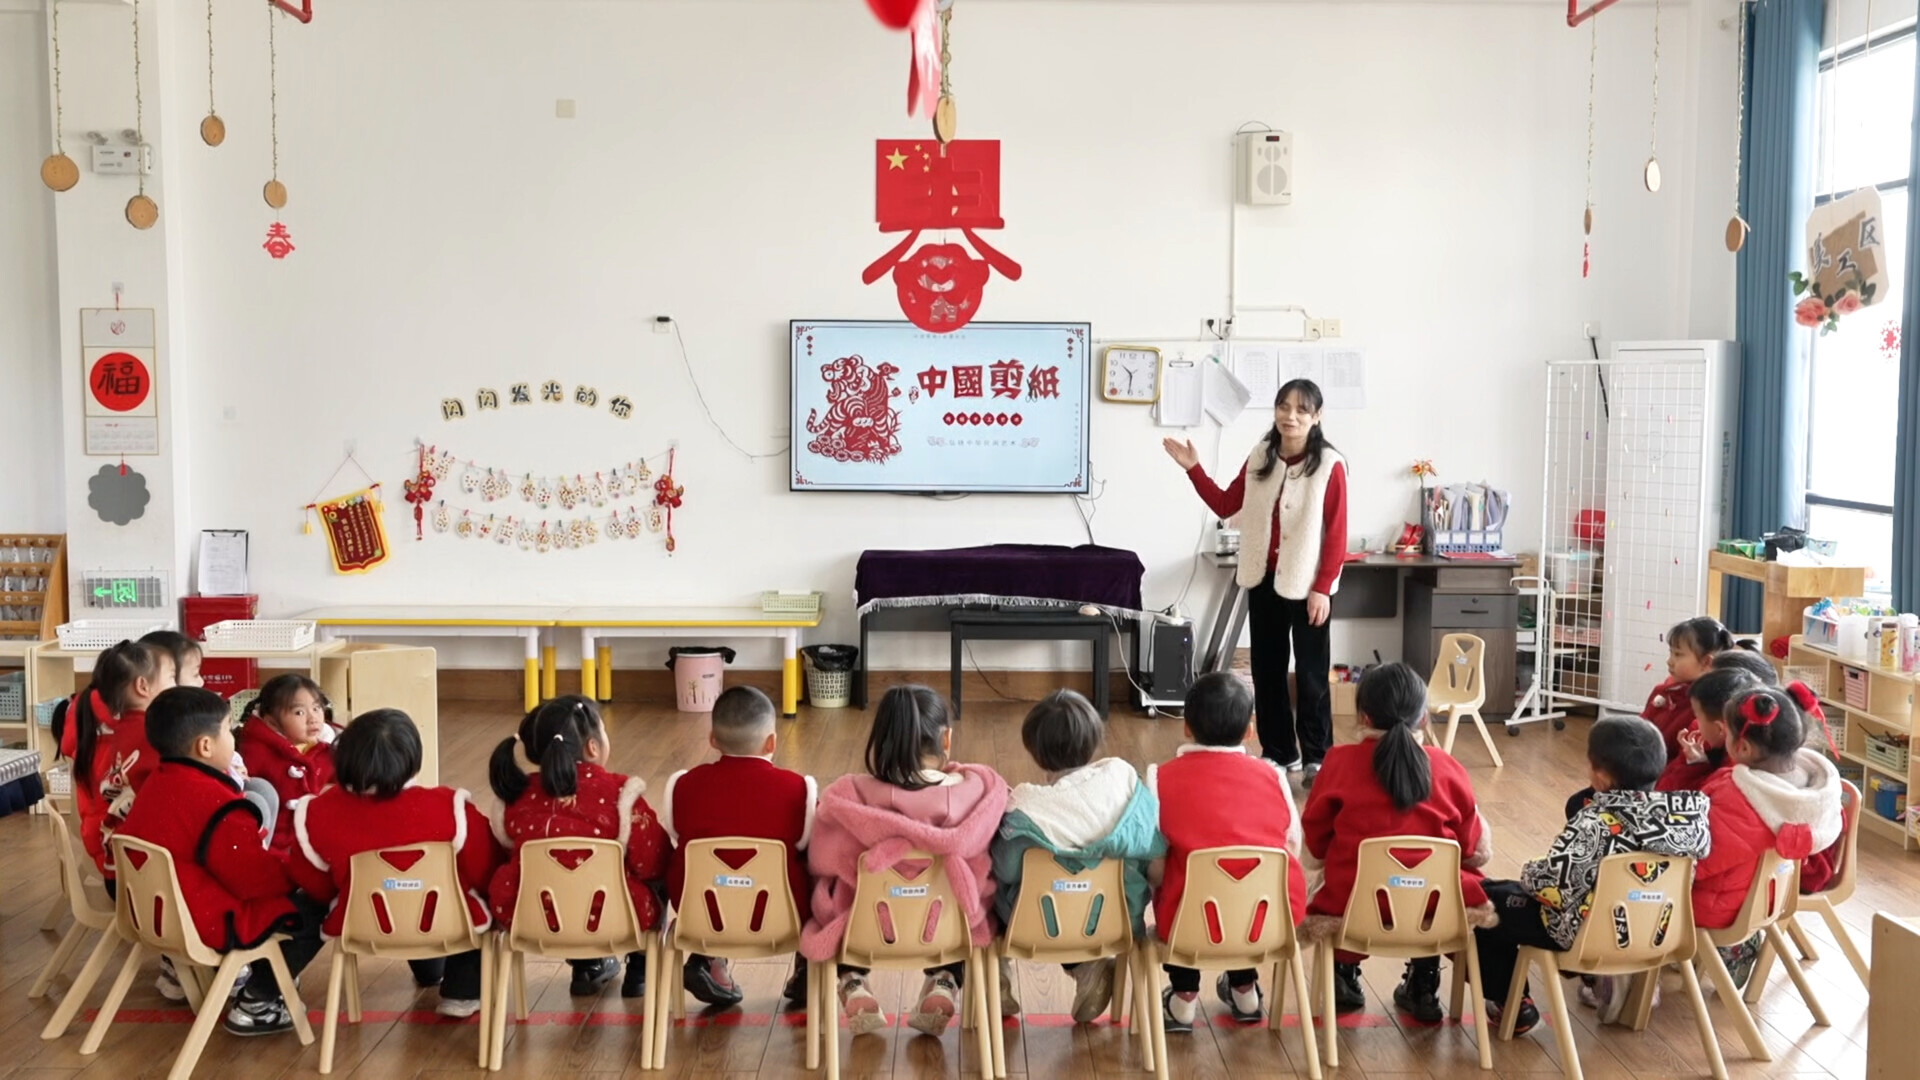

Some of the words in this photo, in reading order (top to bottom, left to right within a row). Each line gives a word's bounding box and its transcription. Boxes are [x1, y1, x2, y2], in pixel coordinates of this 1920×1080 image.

[262, 222, 295, 259] 春
[97, 361, 141, 396] 福
[441, 380, 634, 420] 闪闪发光的你
[1671, 796, 1703, 812] RAP
